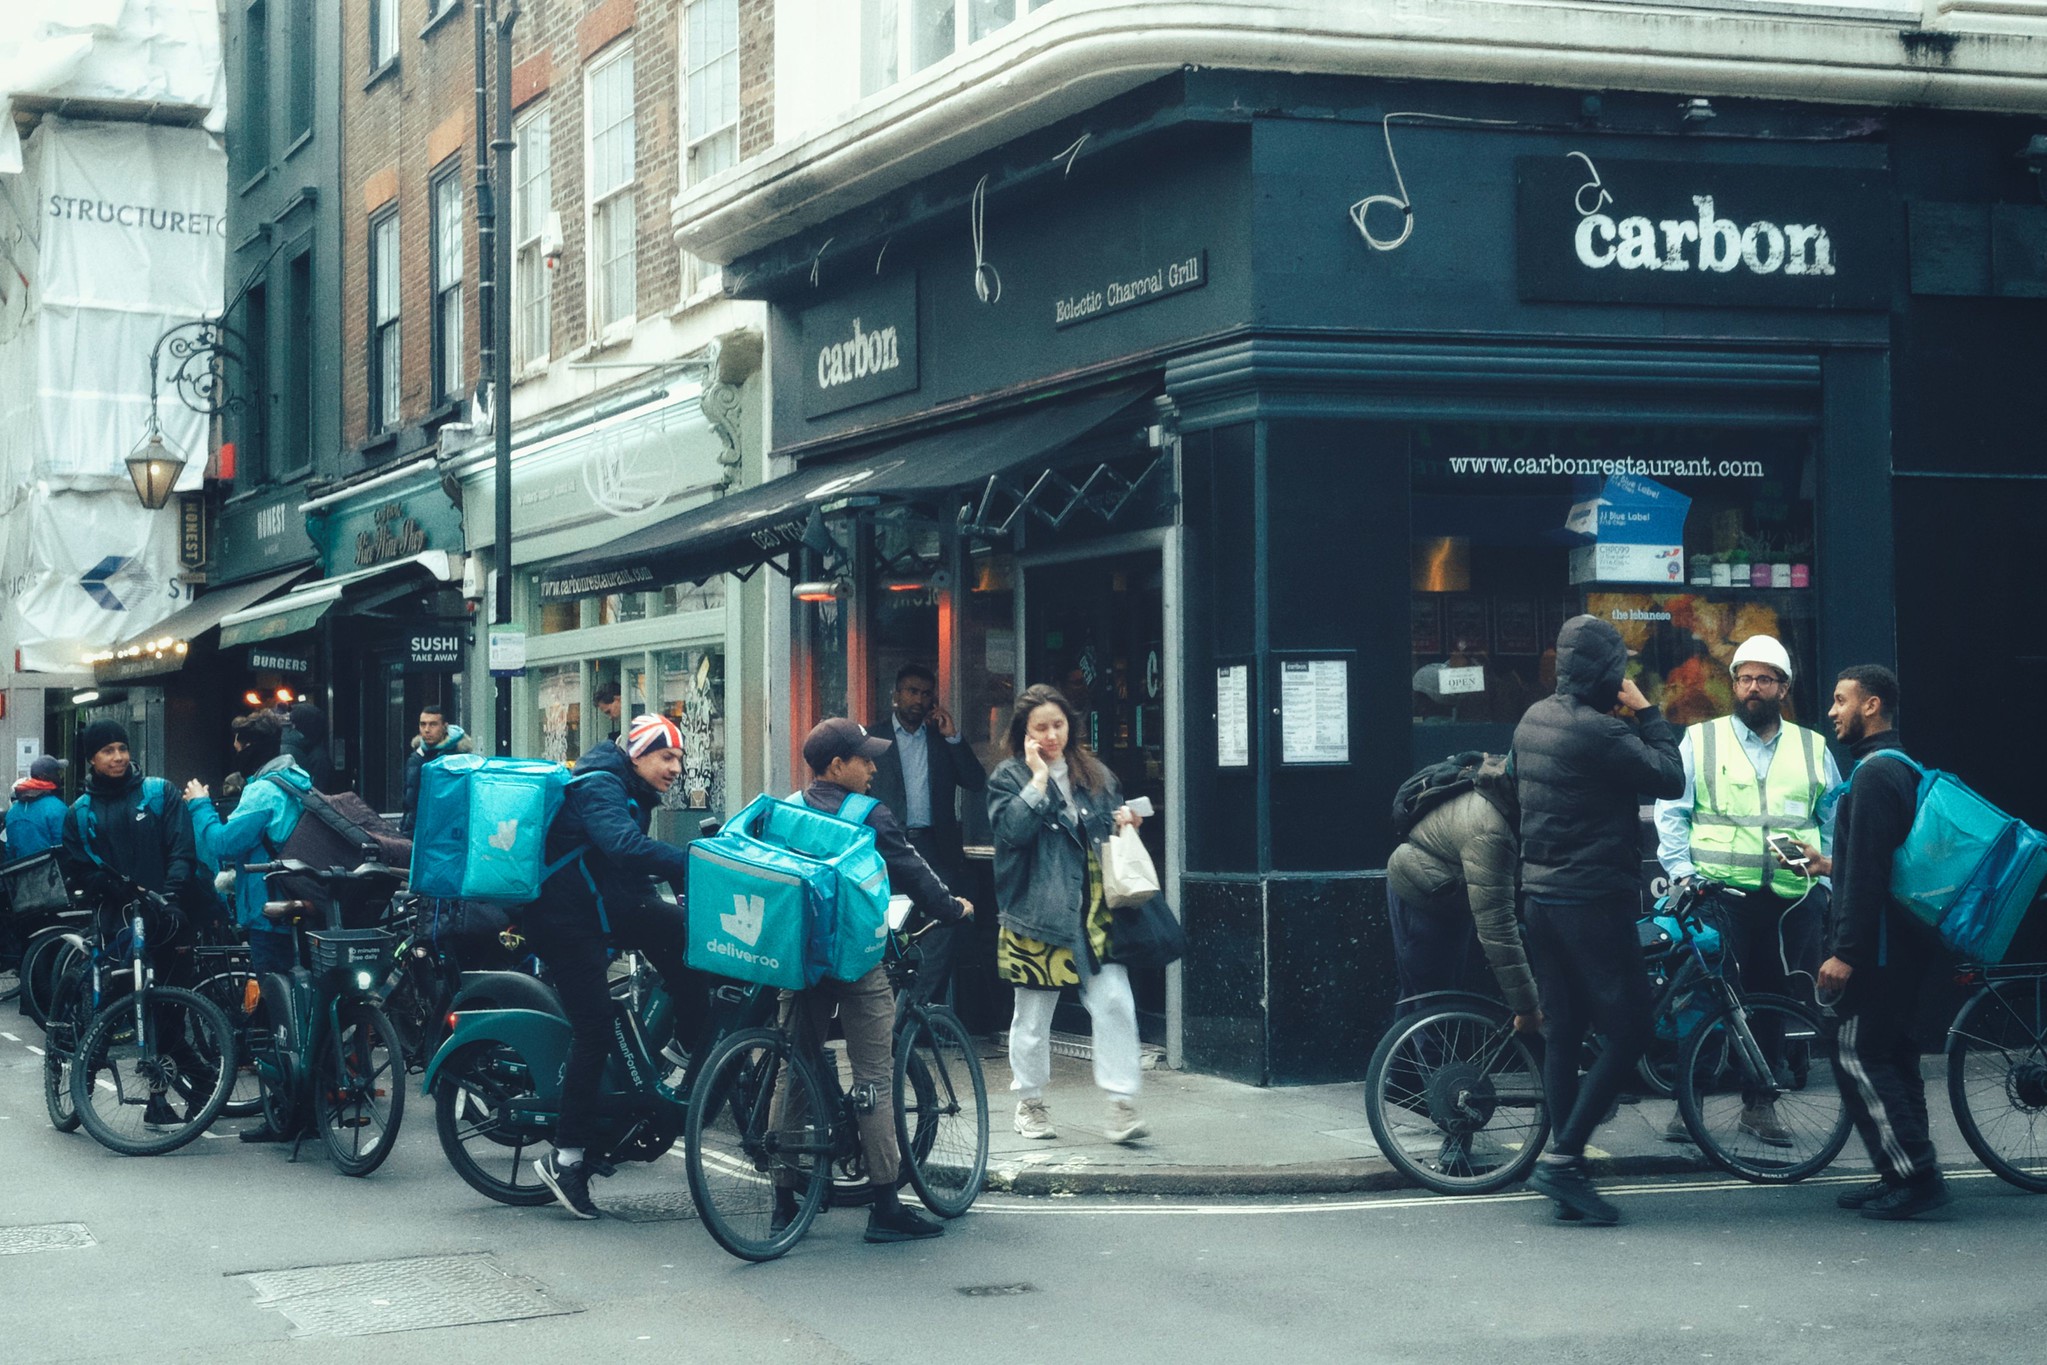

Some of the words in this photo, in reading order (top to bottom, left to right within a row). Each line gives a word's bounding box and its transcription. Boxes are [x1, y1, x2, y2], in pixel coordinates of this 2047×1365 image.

[1575, 195, 1836, 275] carbon
[1056, 290, 1102, 323] Eclectic
[1107, 268, 1163, 307] Charcoal
[1168, 256, 1199, 288] Grill
[818, 317, 899, 389] carbon
[1449, 454, 1764, 477] www.carbonrestaurant.com
[1638, 482, 1660, 499] Label
[257, 503, 286, 541] HONEST
[1609, 511, 1625, 520] Blue
[1628, 511, 1650, 521] Label
[185, 503, 199, 560] HONEST
[1611, 608, 1628, 620] the
[1630, 608, 1671, 620] lebanese
[411, 637, 458, 651] SUSHI
[252, 655, 308, 672] BURGERS
[412, 653, 433, 662] TAKE
[434, 653, 457, 662] AWAY
[1449, 678, 1475, 687] OPEN
[706, 938, 780, 969] deliveroo
